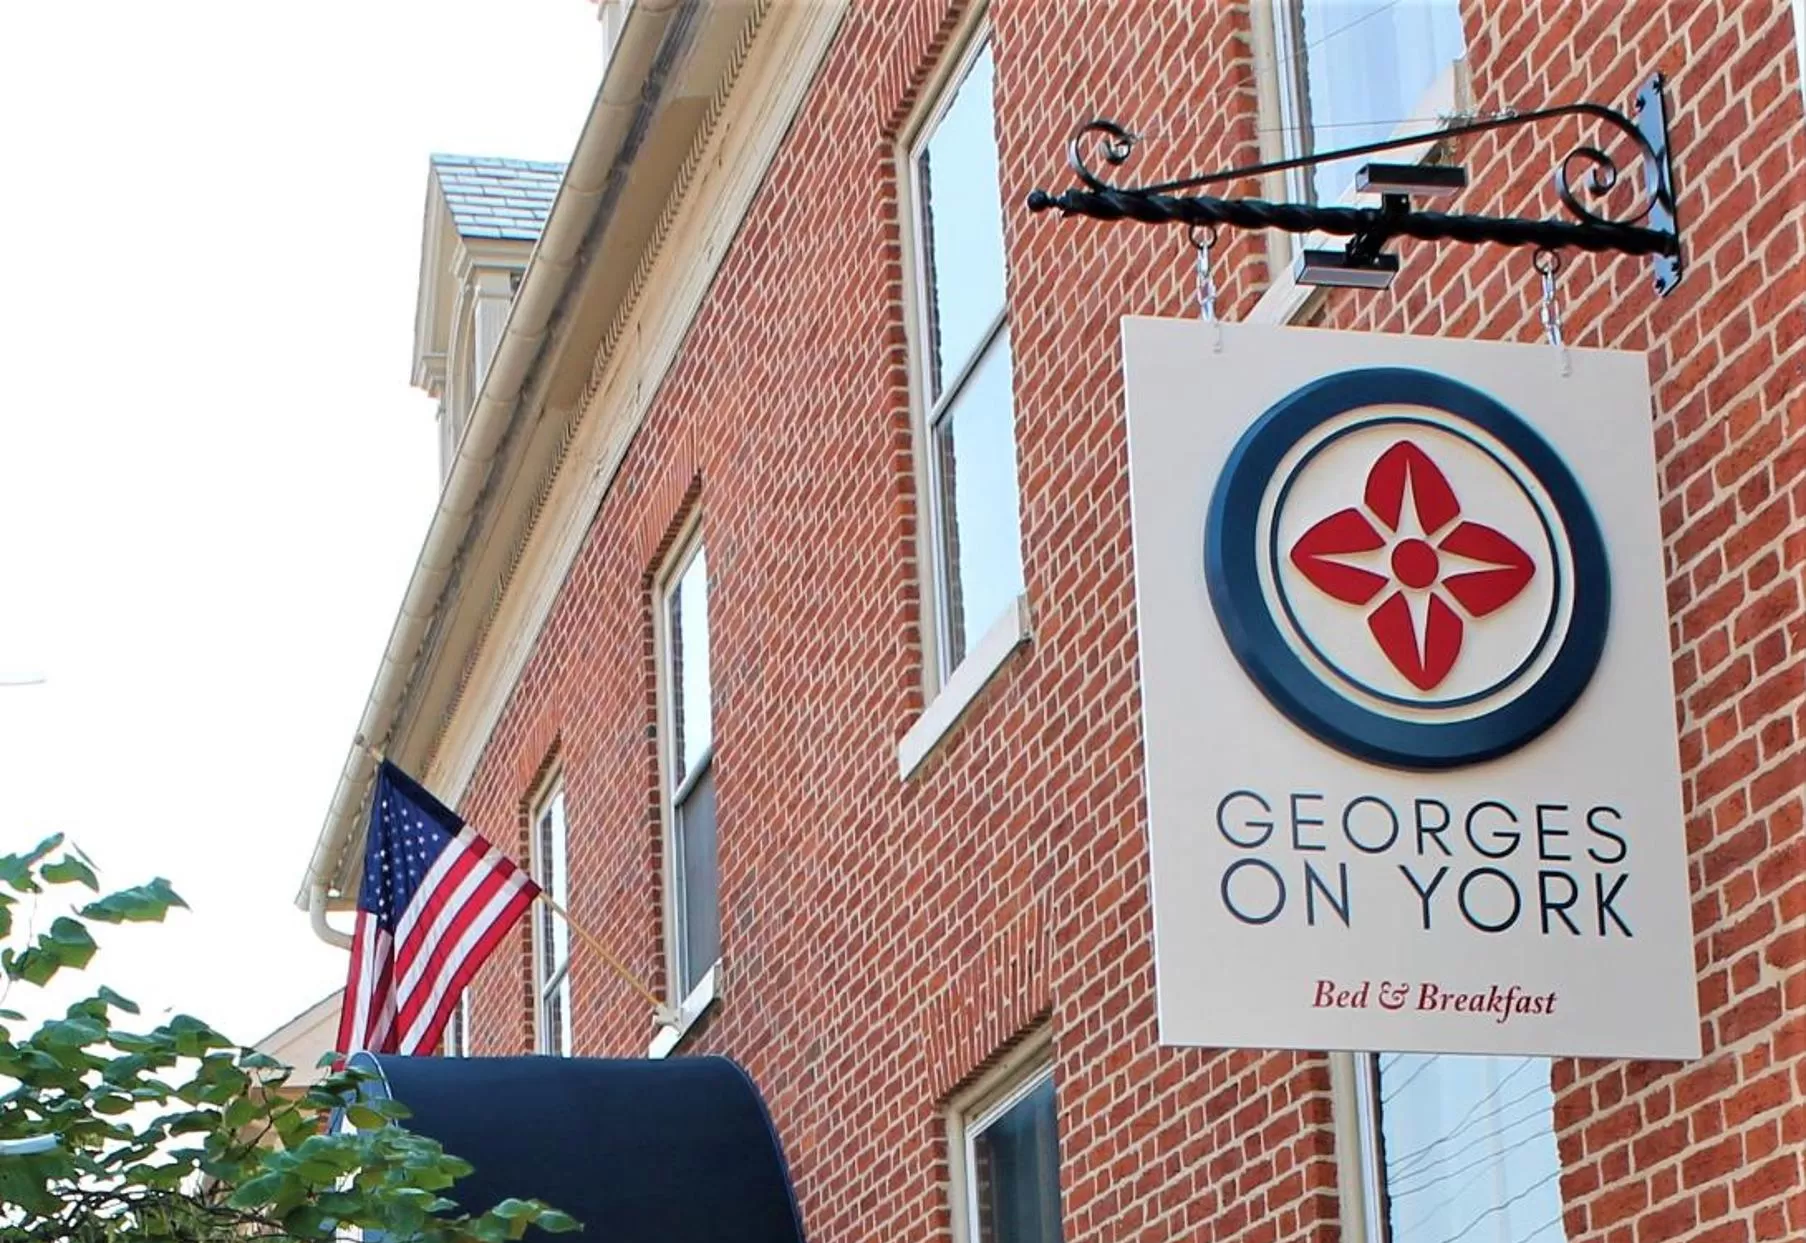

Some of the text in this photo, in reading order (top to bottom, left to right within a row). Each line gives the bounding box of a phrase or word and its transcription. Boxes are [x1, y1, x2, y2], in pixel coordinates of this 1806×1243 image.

[1216, 790, 1628, 865] GEORGES
[1220, 857, 1634, 938] ON YORK
[1312, 979, 1558, 1025] Bed & Breakfast
